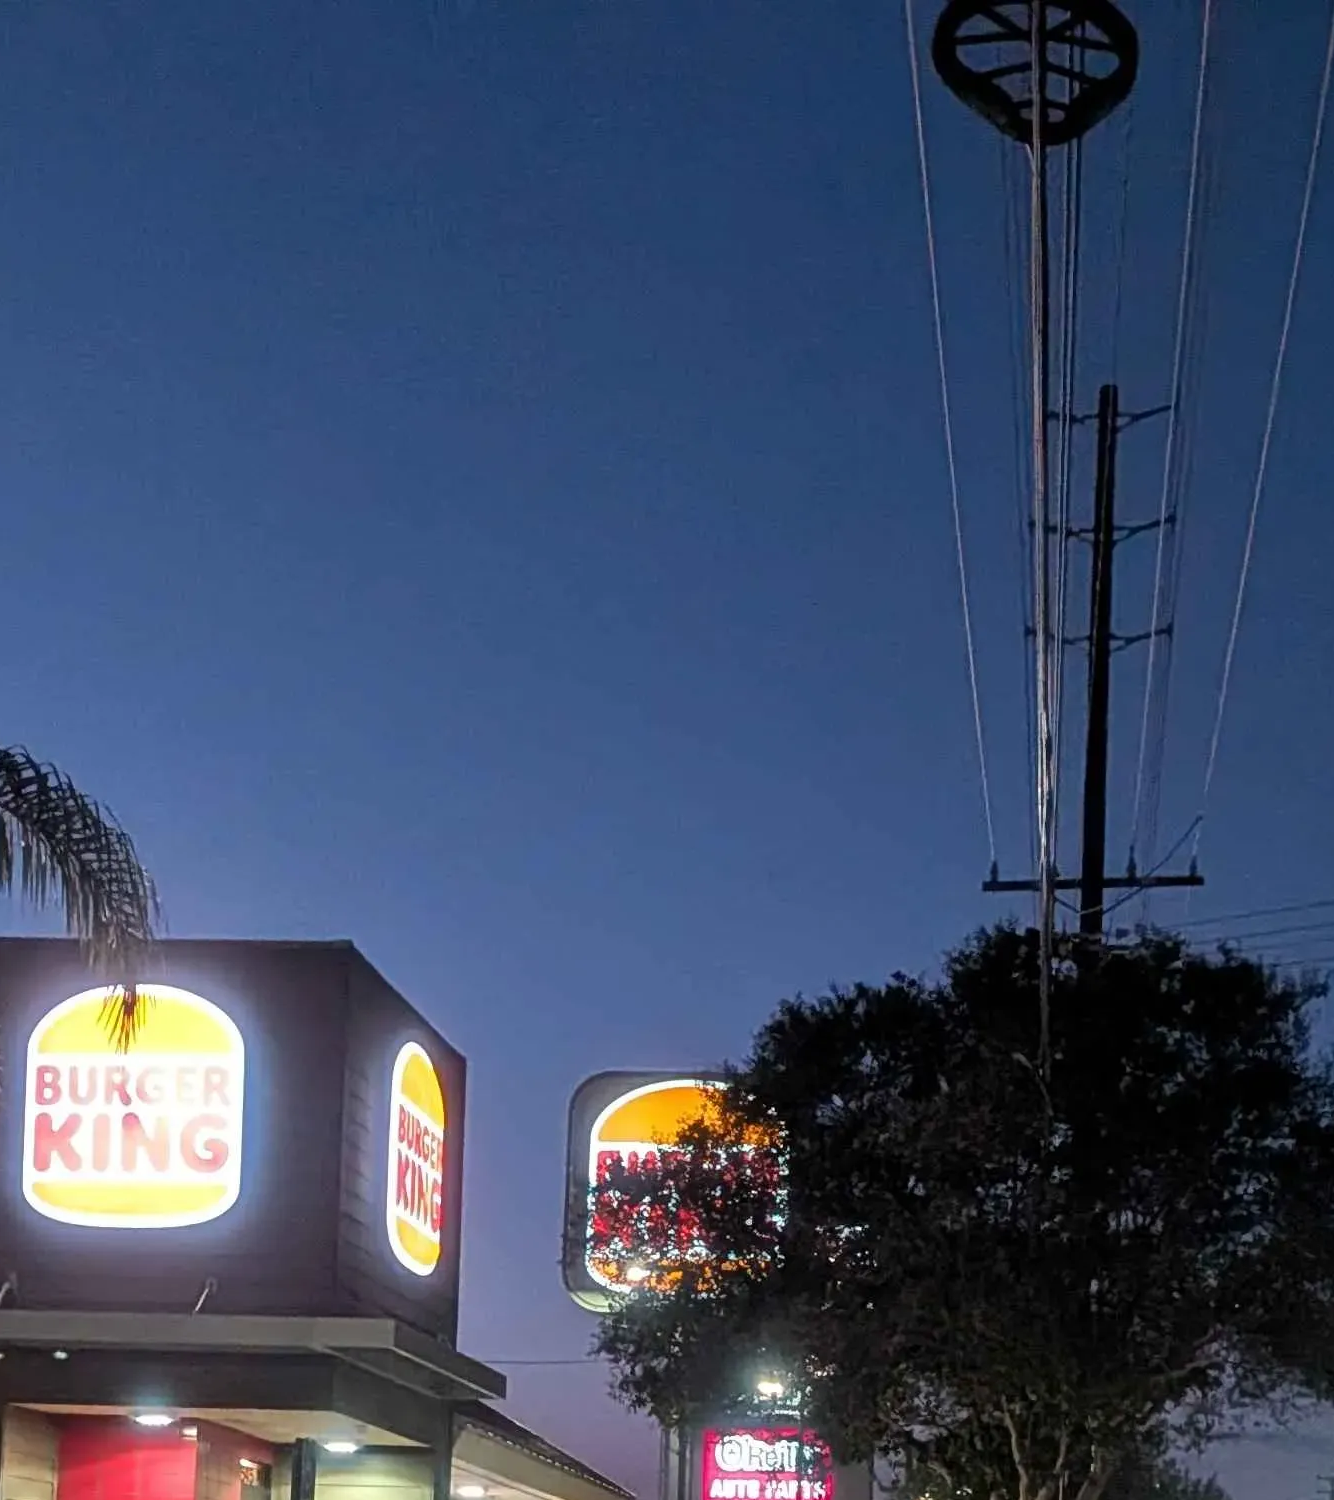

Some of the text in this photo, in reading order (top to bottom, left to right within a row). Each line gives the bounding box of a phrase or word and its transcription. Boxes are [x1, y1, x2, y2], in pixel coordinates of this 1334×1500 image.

[34, 1065, 231, 1106] BURGER
[33, 1112, 229, 1173] KING
[396, 1147, 441, 1233] KING
[709, 1478, 761, 1499] AUTO
